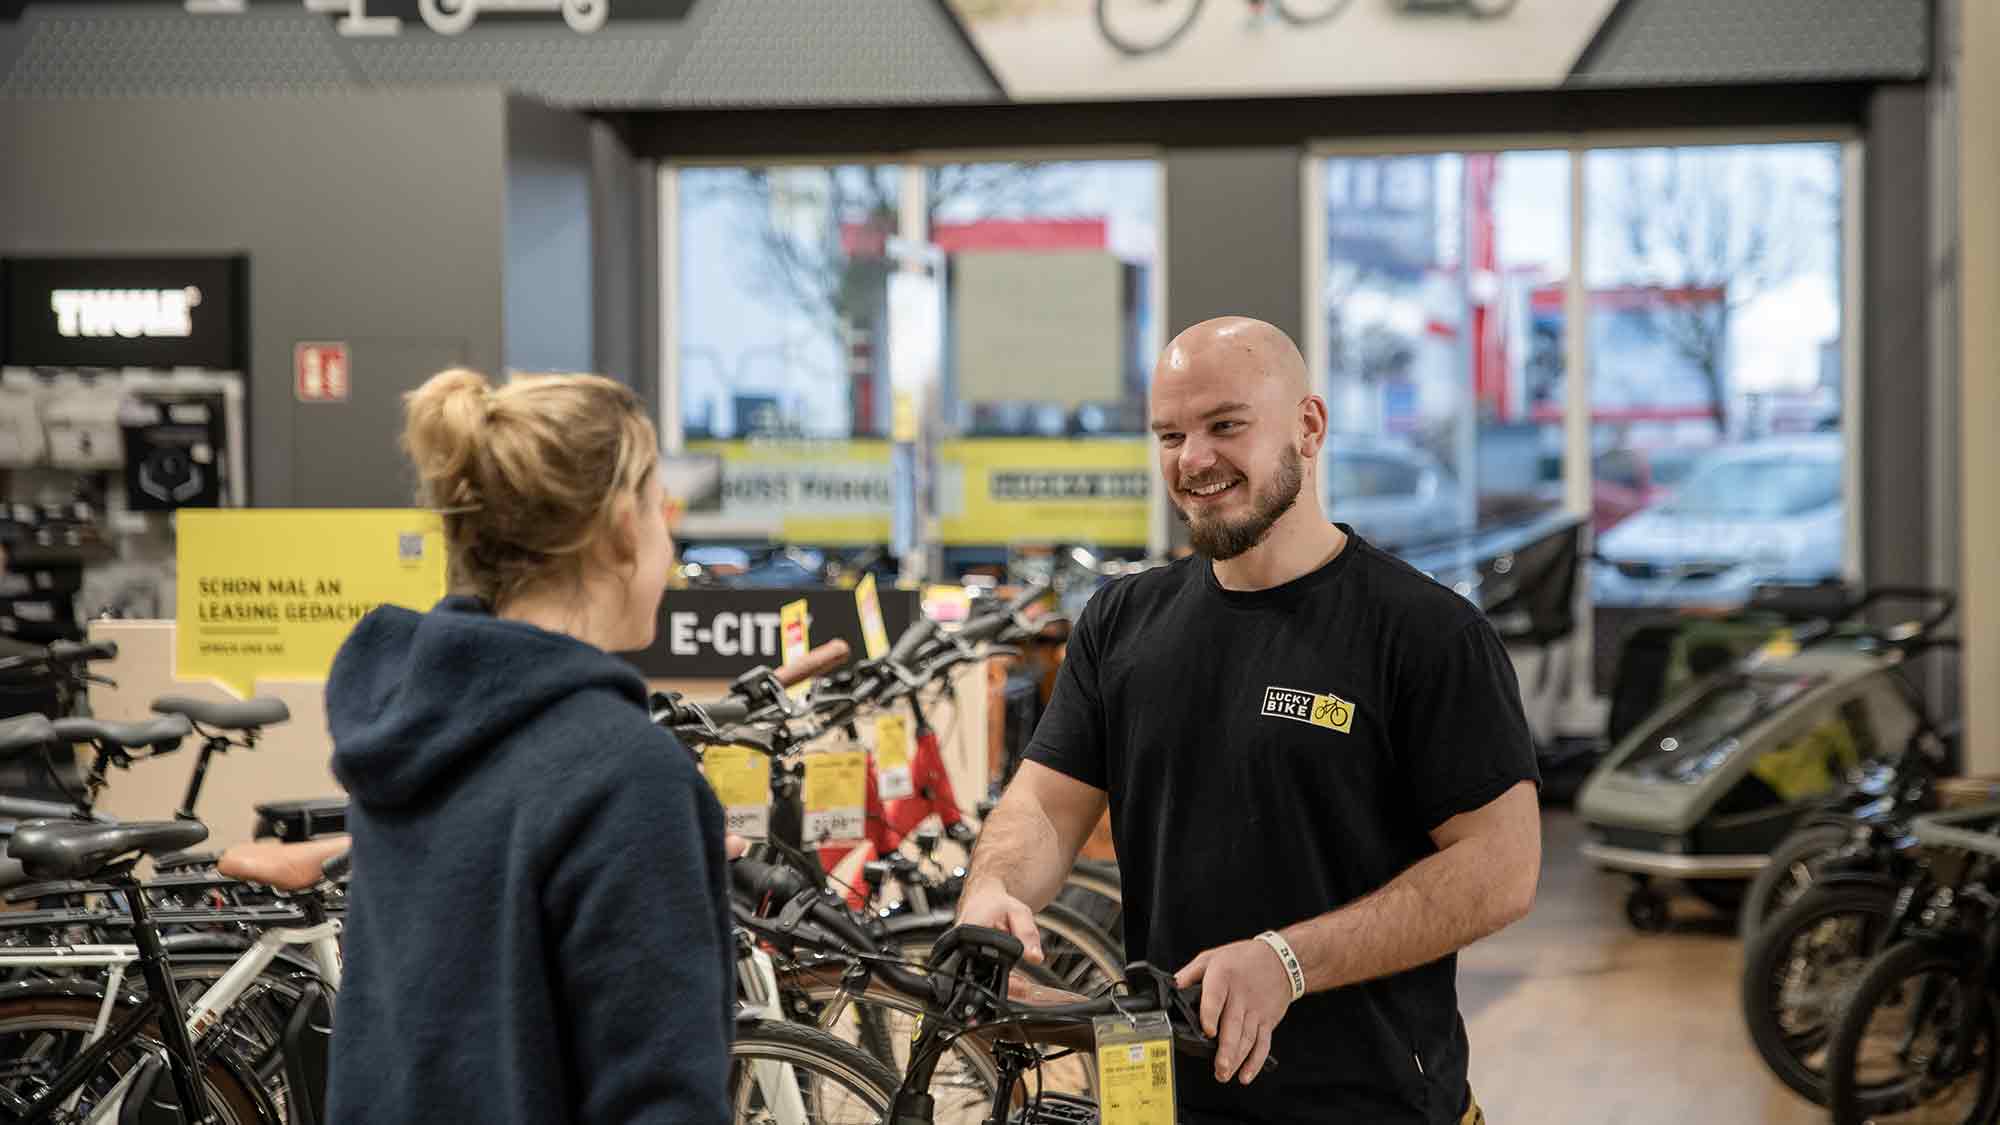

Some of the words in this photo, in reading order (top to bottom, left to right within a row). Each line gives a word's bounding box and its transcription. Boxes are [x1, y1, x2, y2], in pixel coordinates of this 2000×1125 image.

[199, 579, 262, 595] SCHON
[267, 579, 306, 595] MAL
[313, 579, 342, 595] AN
[198, 603, 279, 621] LEASING
[1269, 691, 1311, 705] LUCKY
[1266, 700, 1308, 717] BIKE
